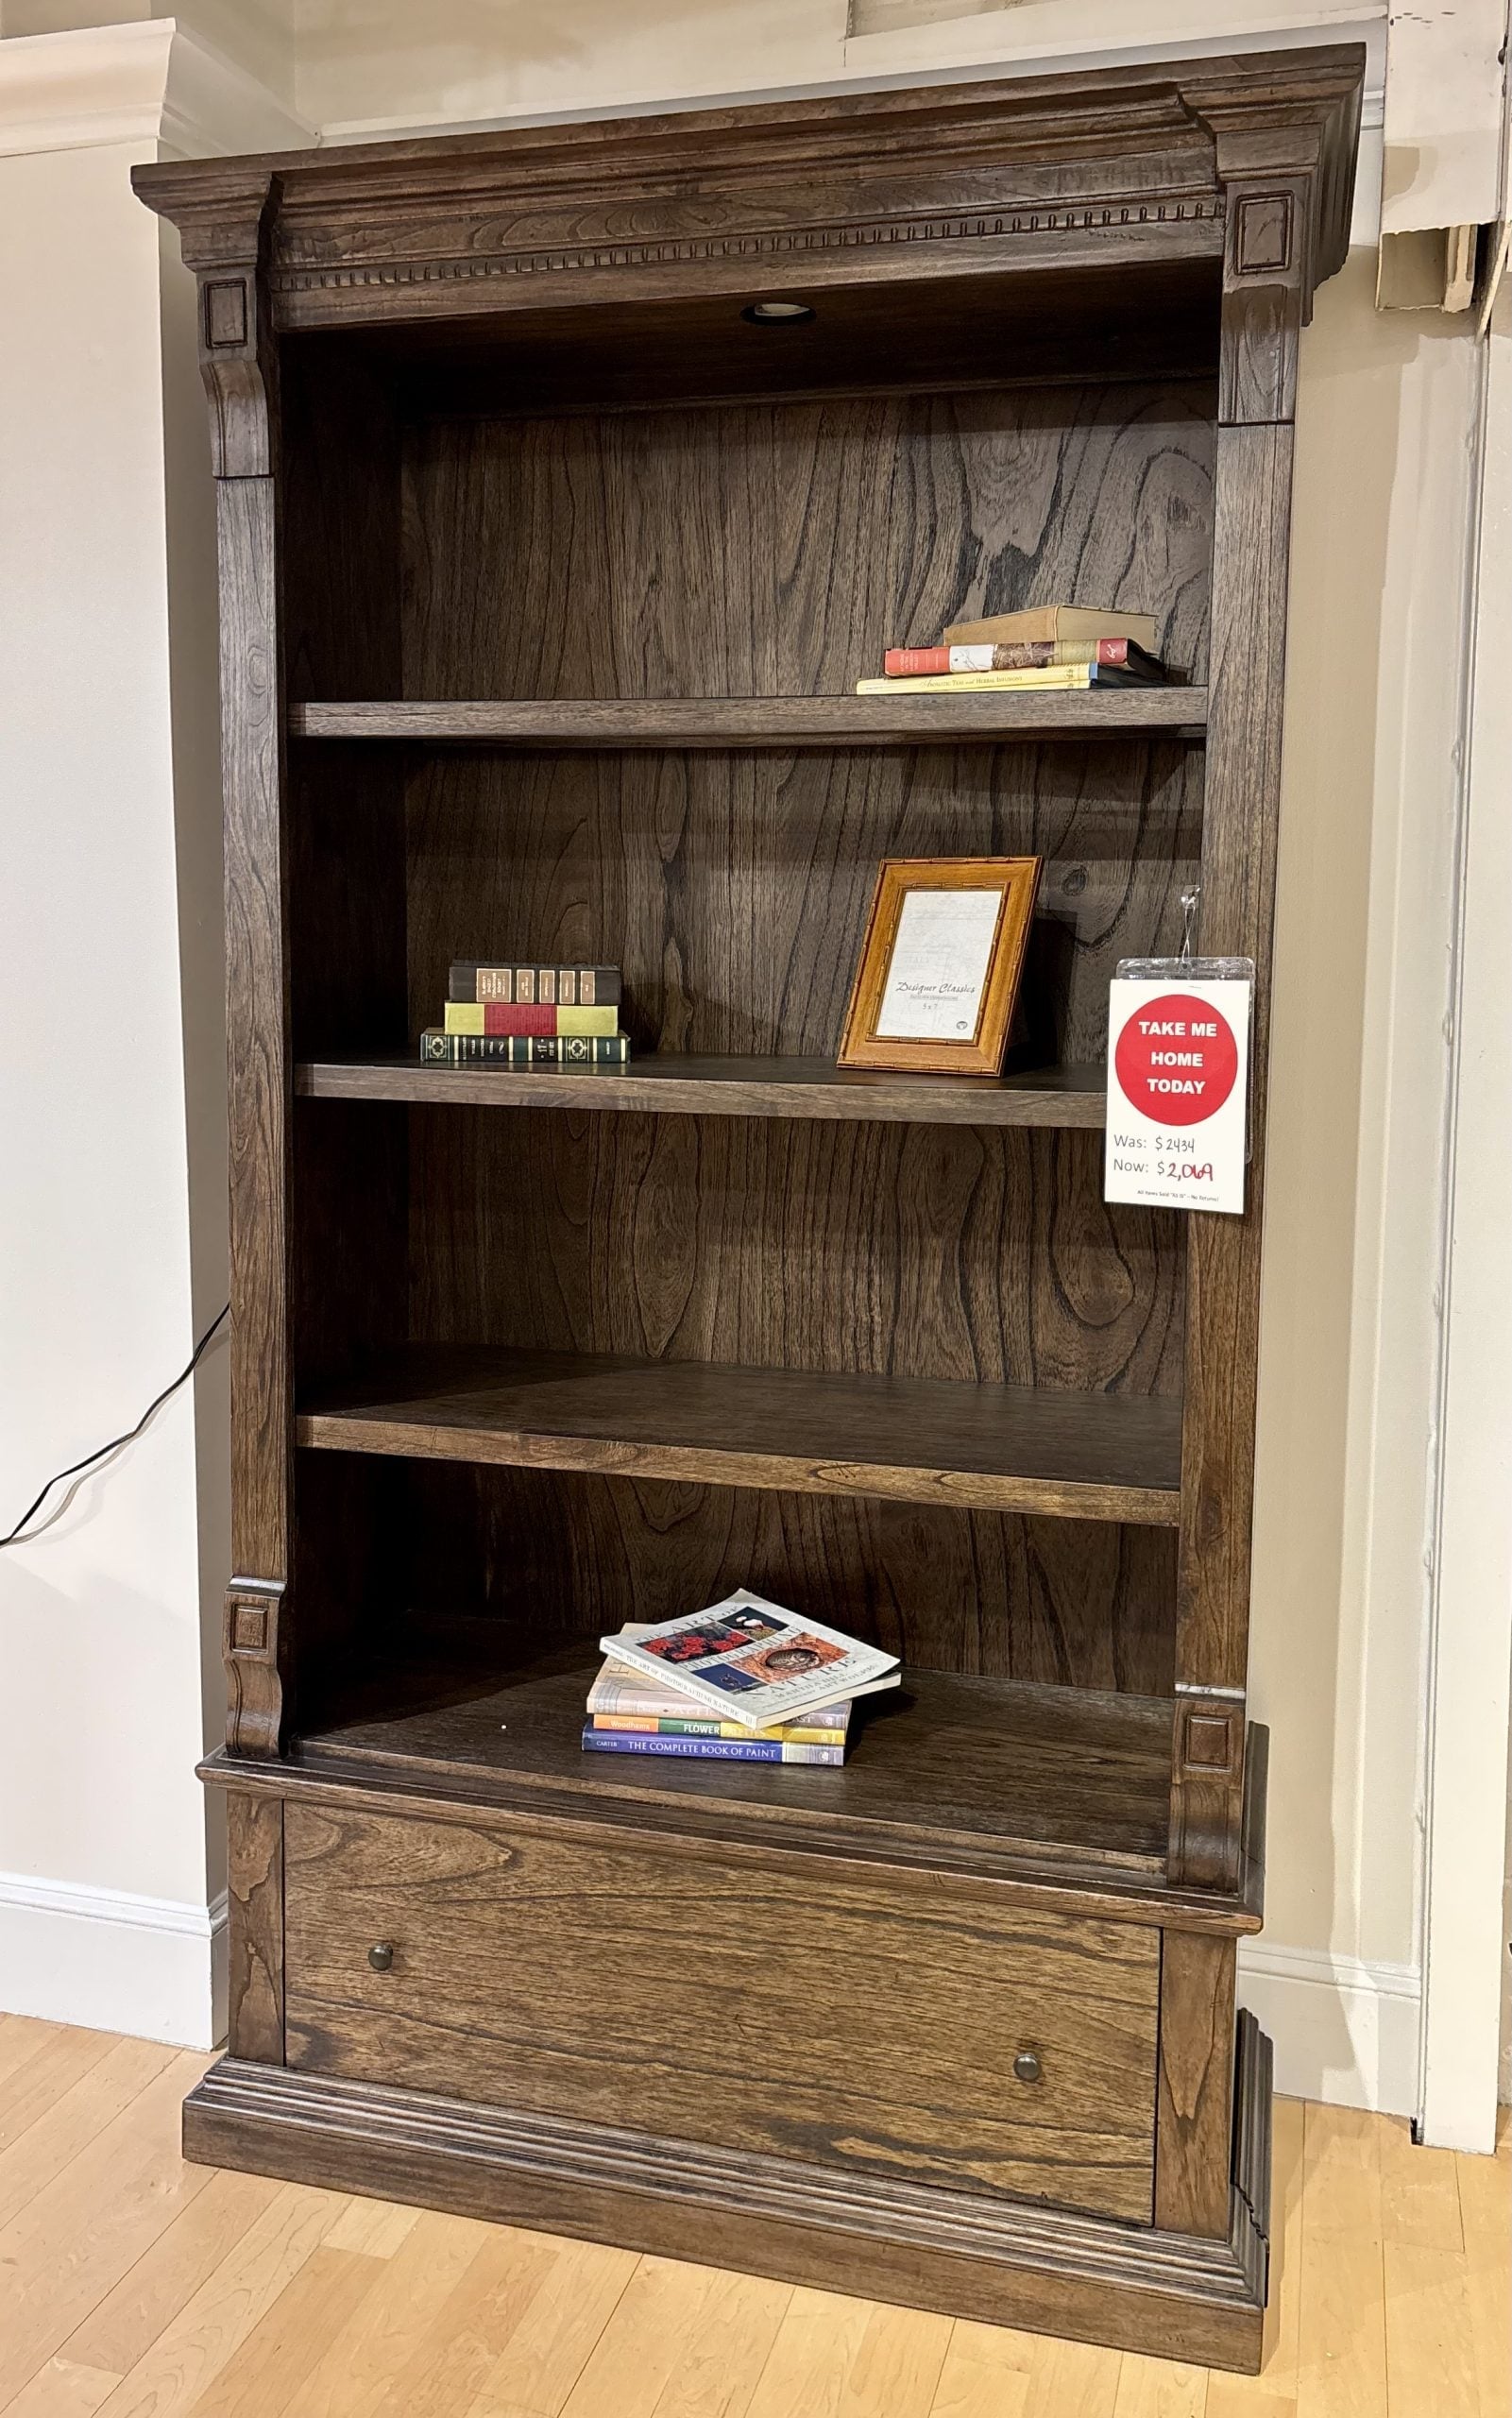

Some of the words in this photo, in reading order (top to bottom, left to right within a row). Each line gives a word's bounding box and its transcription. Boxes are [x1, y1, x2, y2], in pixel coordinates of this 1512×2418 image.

[895, 982, 937, 996] Designer
[939, 983, 976, 994] Classics
[1138, 1021, 1186, 1036] TAKE
[1191, 1023, 1217, 1037] ME
[1150, 1051, 1203, 1067] HOME
[1147, 1078, 1206, 1095] TODAY
[1113, 1134, 1147, 1149] Was:
[1113, 1158, 1149, 1173] Now:
[671, 1613, 715, 1633] ART
[677, 1625, 803, 1671] PHOTOGRAPHING
[744, 1659, 857, 1699] NATURE
[610, 1720, 651, 1730] Woodhams
[683, 1724, 721, 1735] FLOWER
[628, 1741, 647, 1751] THE
[649, 1742, 699, 1754] COMPLETE
[701, 1745, 728, 1755] BOOK
[730, 1747, 743, 1756] OF
[746, 1748, 776, 1759] PAINT
